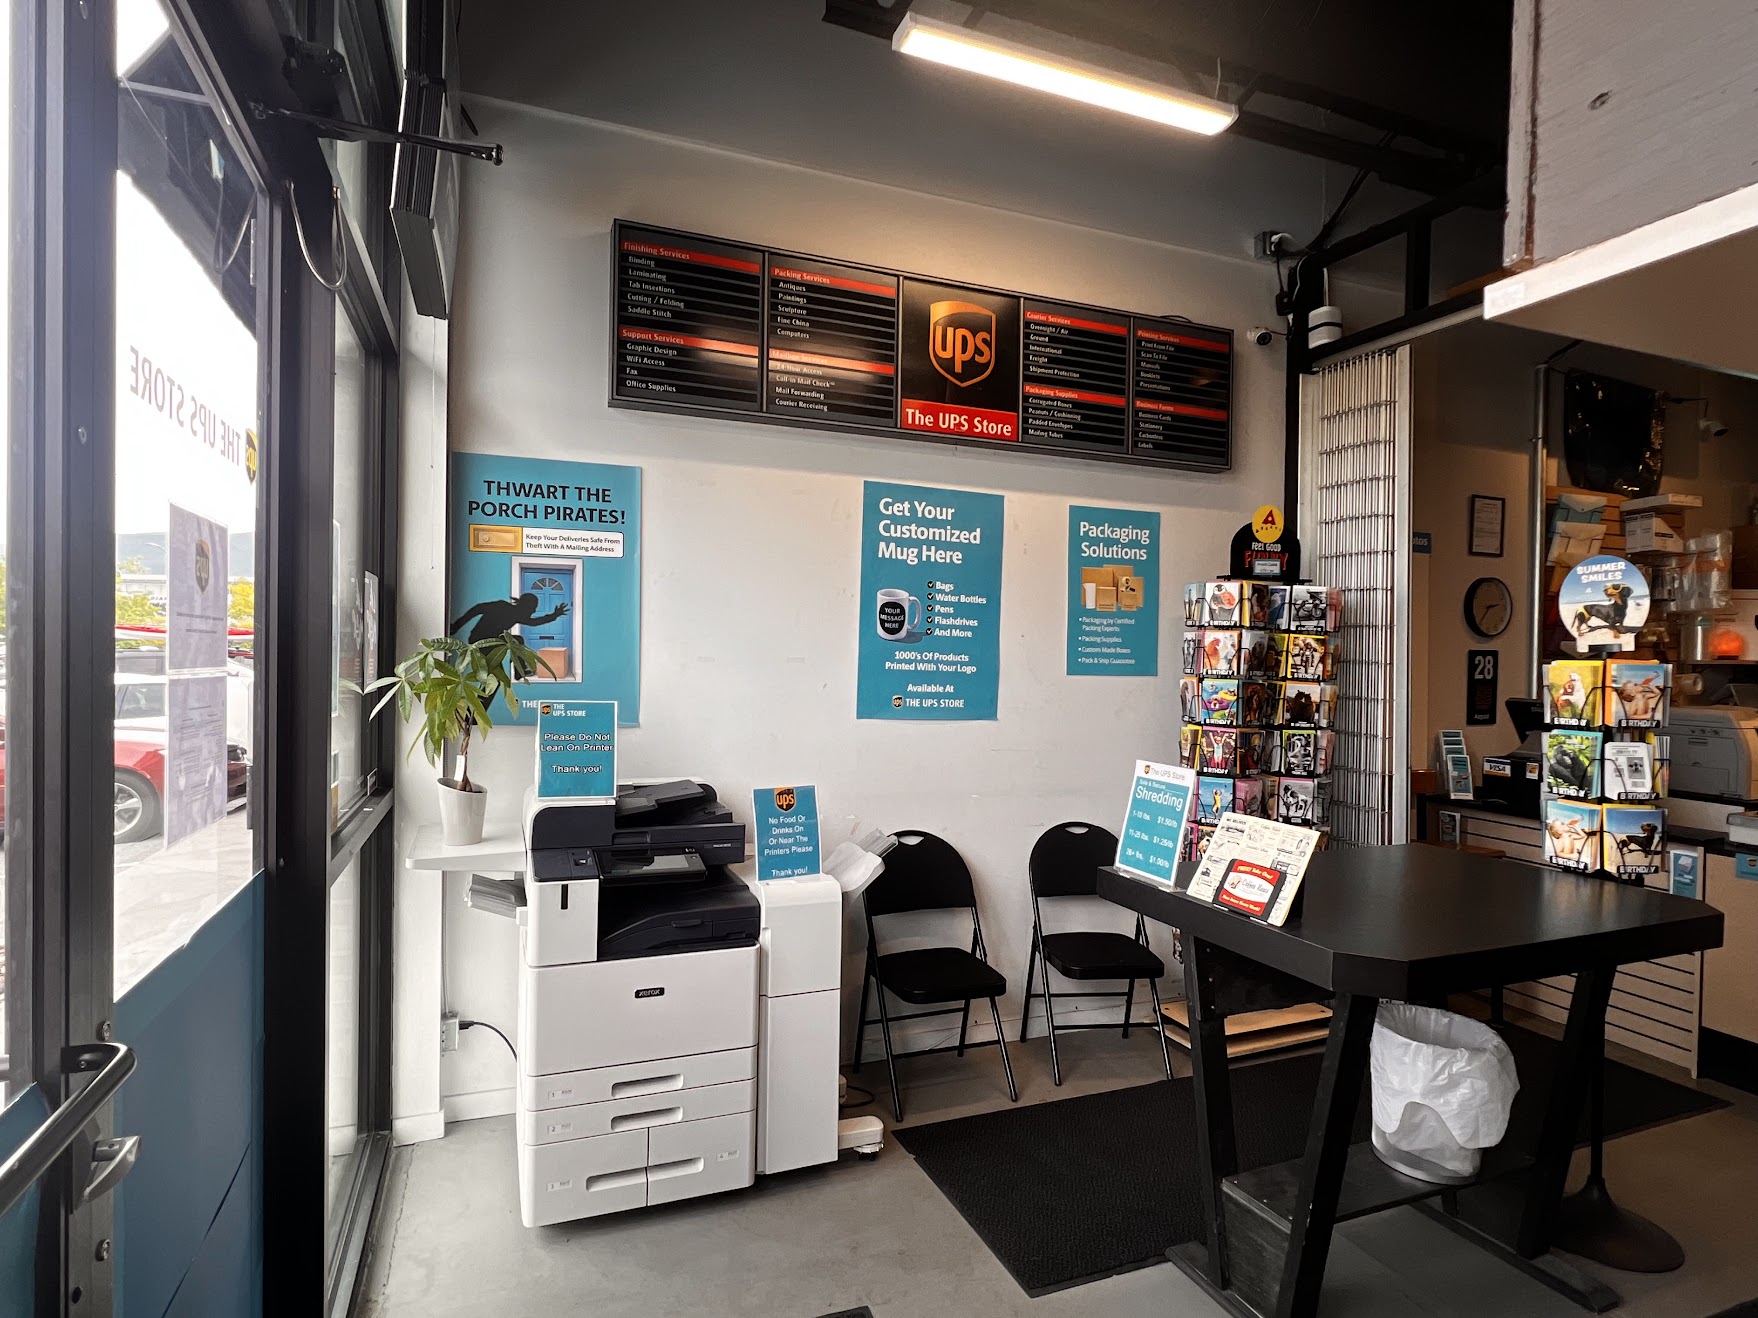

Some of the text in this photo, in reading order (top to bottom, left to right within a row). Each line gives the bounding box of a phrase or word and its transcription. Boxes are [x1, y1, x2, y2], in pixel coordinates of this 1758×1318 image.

[624, 243, 690, 260] Finishing Services
[628, 256, 655, 267] Binding
[628, 268, 667, 281] Laminating
[774, 268, 830, 284] Packing Services
[642, 283, 675, 294] Insertions
[779, 282, 806, 292] Antiques
[627, 293, 685, 309] Cutting Folding
[778, 293, 807, 304] Paintings
[627, 306, 672, 318] Saddle Stitch
[778, 305, 807, 315] Sculpture
[777, 316, 809, 327] Fine China
[1048, 315, 1071, 325] Services
[622, 329, 684, 344] Support Services
[777, 328, 810, 339] Computers
[1030, 334, 1049, 342] Ground
[626, 343, 677, 356] Graphic Design
[934, 325, 991, 374] ups
[643, 357, 665, 366] Access
[626, 367, 638, 375] Fax
[802, 367, 823, 375] Access
[1029, 365, 1080, 378] Shipment Protection
[626, 380, 676, 392] Office Supplies
[775, 387, 825, 400] Mail Forwarding
[1025, 386, 1078, 399] Packaging Supplies
[775, 398, 828, 412] Courier Receiving
[905, 408, 1012, 436] The UPS Store
[1028, 418, 1048, 427] Padded
[1028, 429, 1048, 438] Mailing
[483, 480, 612, 503] THWART THE
[468, 500, 626, 525] PORCH PIRATES!
[879, 497, 955, 520] Get Your
[878, 520, 981, 544] Customized
[1079, 521, 1150, 545] Packaging
[525, 533, 542, 541] Keep
[558, 535, 590, 543] Deliveries
[878, 541, 963, 565] Mug Here
[1081, 542, 1147, 560] Solutions
[1576, 562, 1626, 575] SUMMER
[1581, 572, 1623, 583] SMILES
[935, 581, 954, 592] Bags
[935, 593, 987, 604] Water Bottles
[935, 604, 954, 614] Pens
[880, 613, 905, 621] MESSAGE
[935, 616, 978, 627] Flashdrives
[934, 628, 973, 638] And More
[894, 651, 969, 662] 1000's Of Products
[885, 662, 977, 674] Printed With Your Logo
[1474, 655, 1493, 679] 28
[907, 683, 954, 693] Available At
[522, 700, 538, 709] THE
[905, 698, 964, 708] THE UPS STORE
[544, 733, 611, 741] Please Do Not
[552, 765, 602, 774] Thank you!
[1489, 764, 1506, 772] VISA
[1151, 767, 1185, 781] The UPS Store
[777, 794, 795, 809] ups
[1135, 785, 1184, 812] Shredding
[772, 827, 793, 835] Drinks
[764, 848, 790, 856] Printers
[771, 866, 808, 877] Thank you!
[639, 989, 660, 997] xerox
